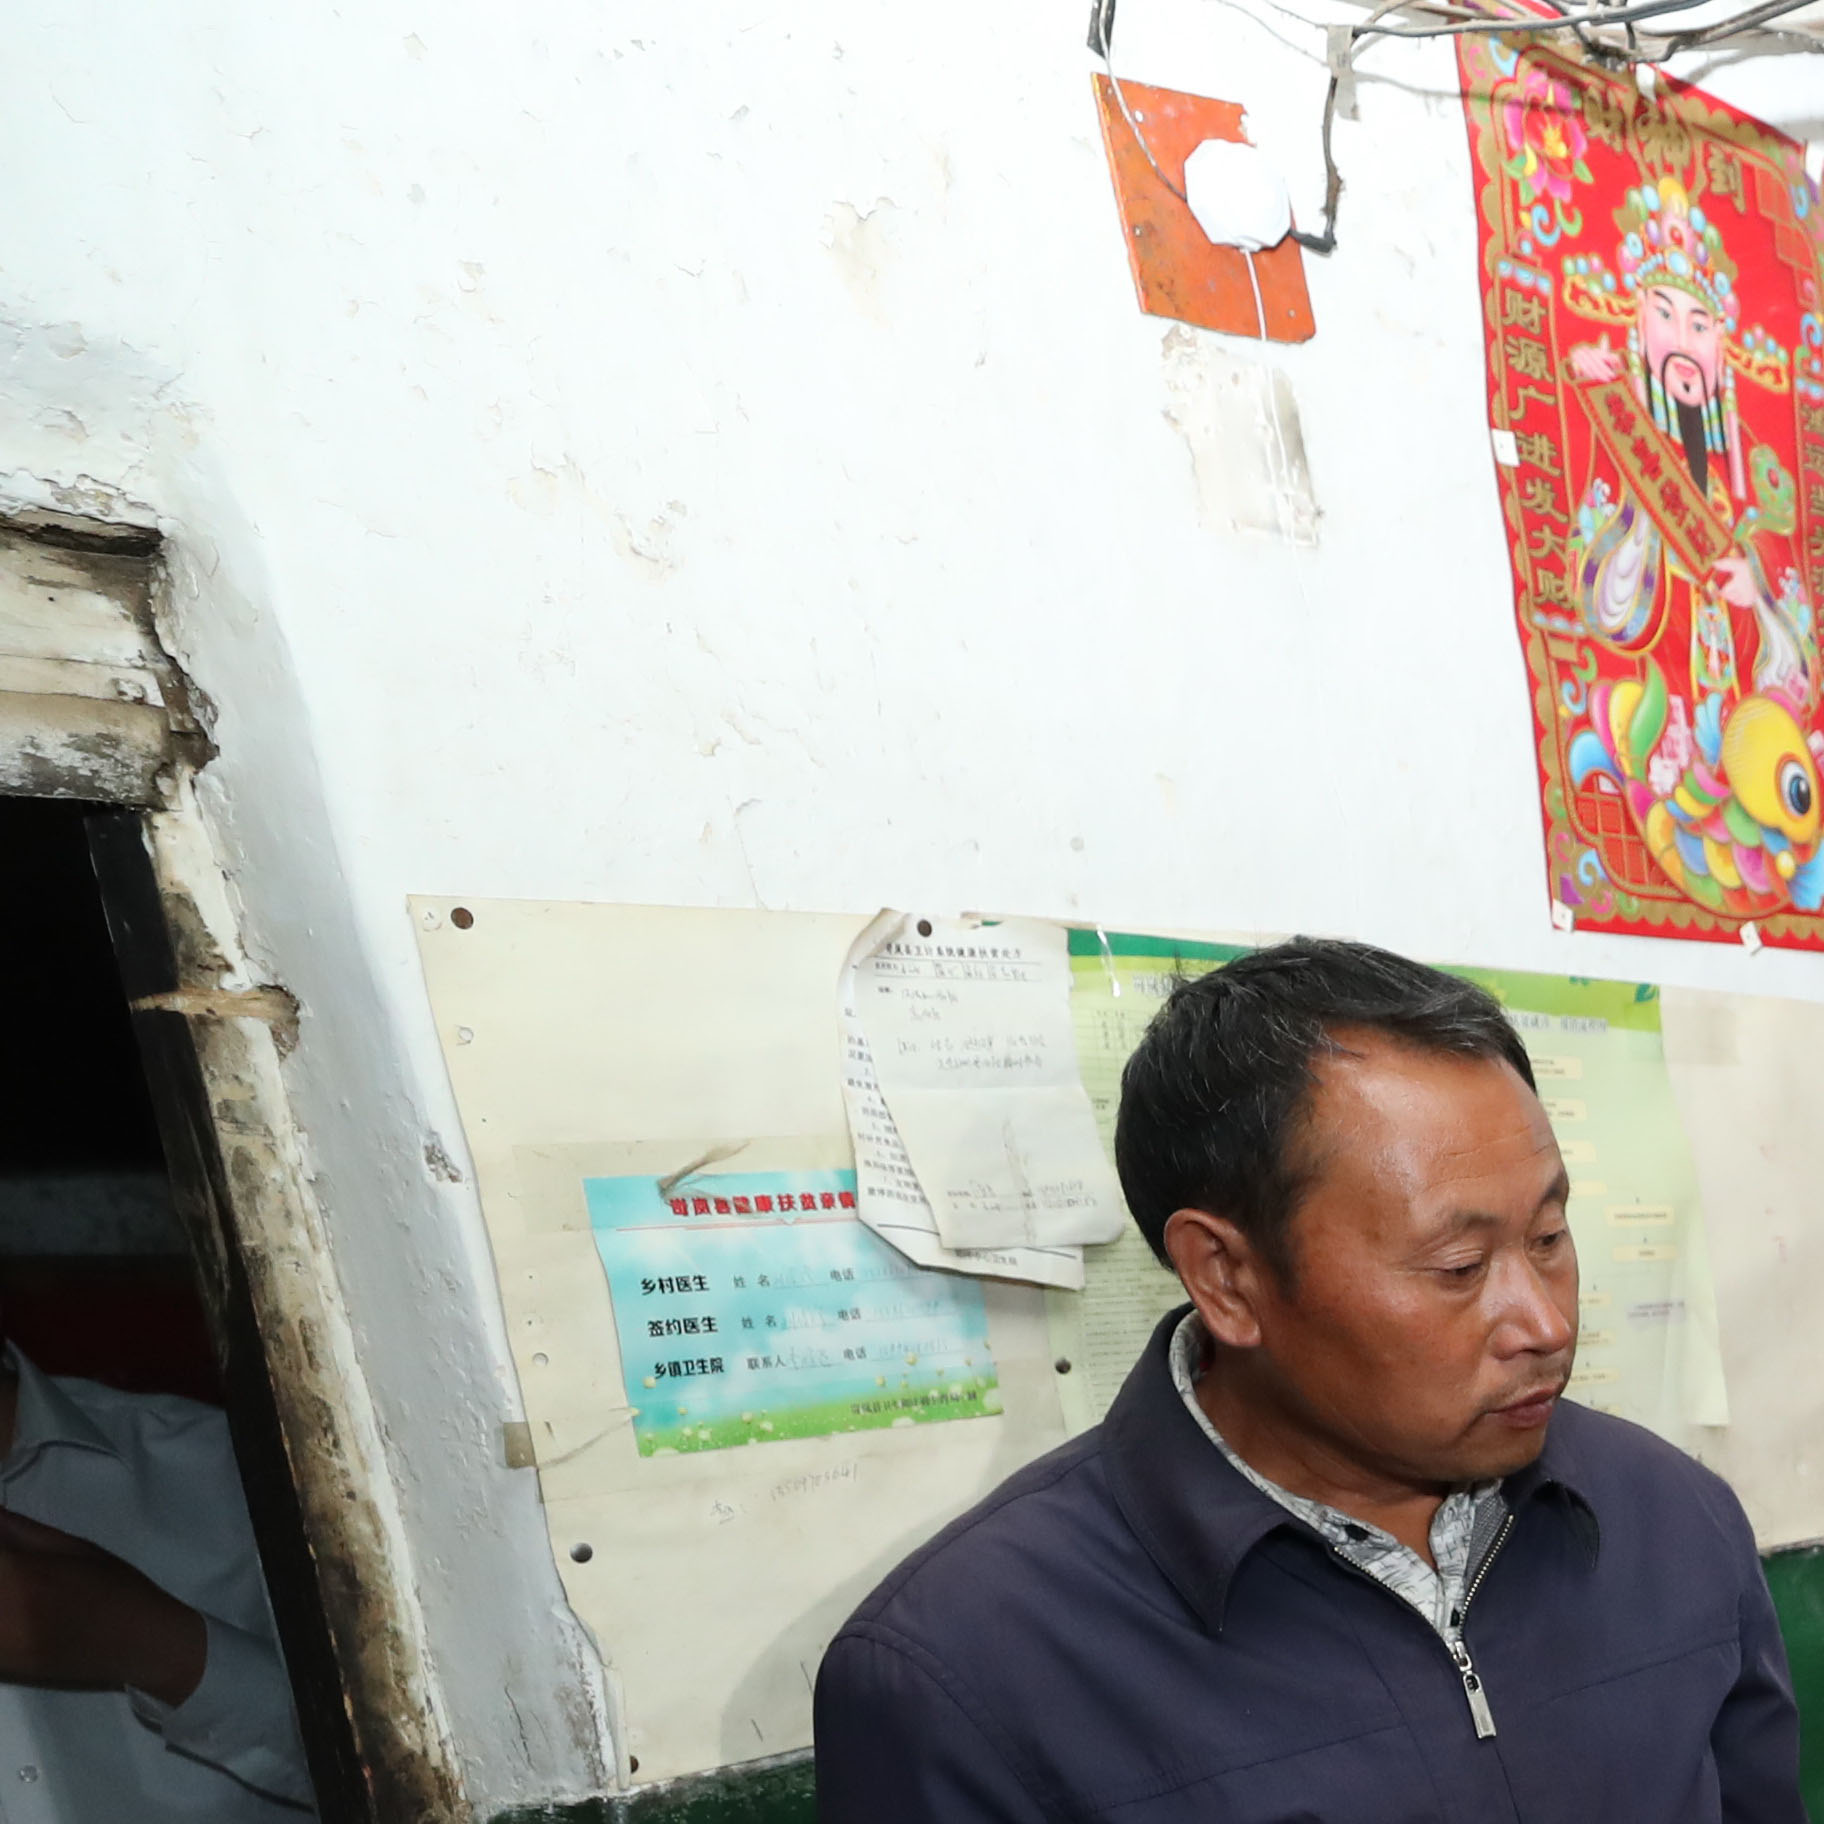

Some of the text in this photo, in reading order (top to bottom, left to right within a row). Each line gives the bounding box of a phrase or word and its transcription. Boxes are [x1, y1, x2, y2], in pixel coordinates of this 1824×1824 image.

[1583, 85, 1747, 214] 财神到
[1501, 287, 1576, 609] 财源广进发大财
[640, 1274, 710, 1296] 乡村医生
[829, 1268, 855, 1282] 电话
[648, 1316, 718, 1338] 签约医生
[838, 1307, 862, 1321] 电话
[654, 1357, 725, 1379] 乡镇卫生院
[747, 1354, 786, 1370] 联系人
[843, 1347, 867, 1360] 电话
